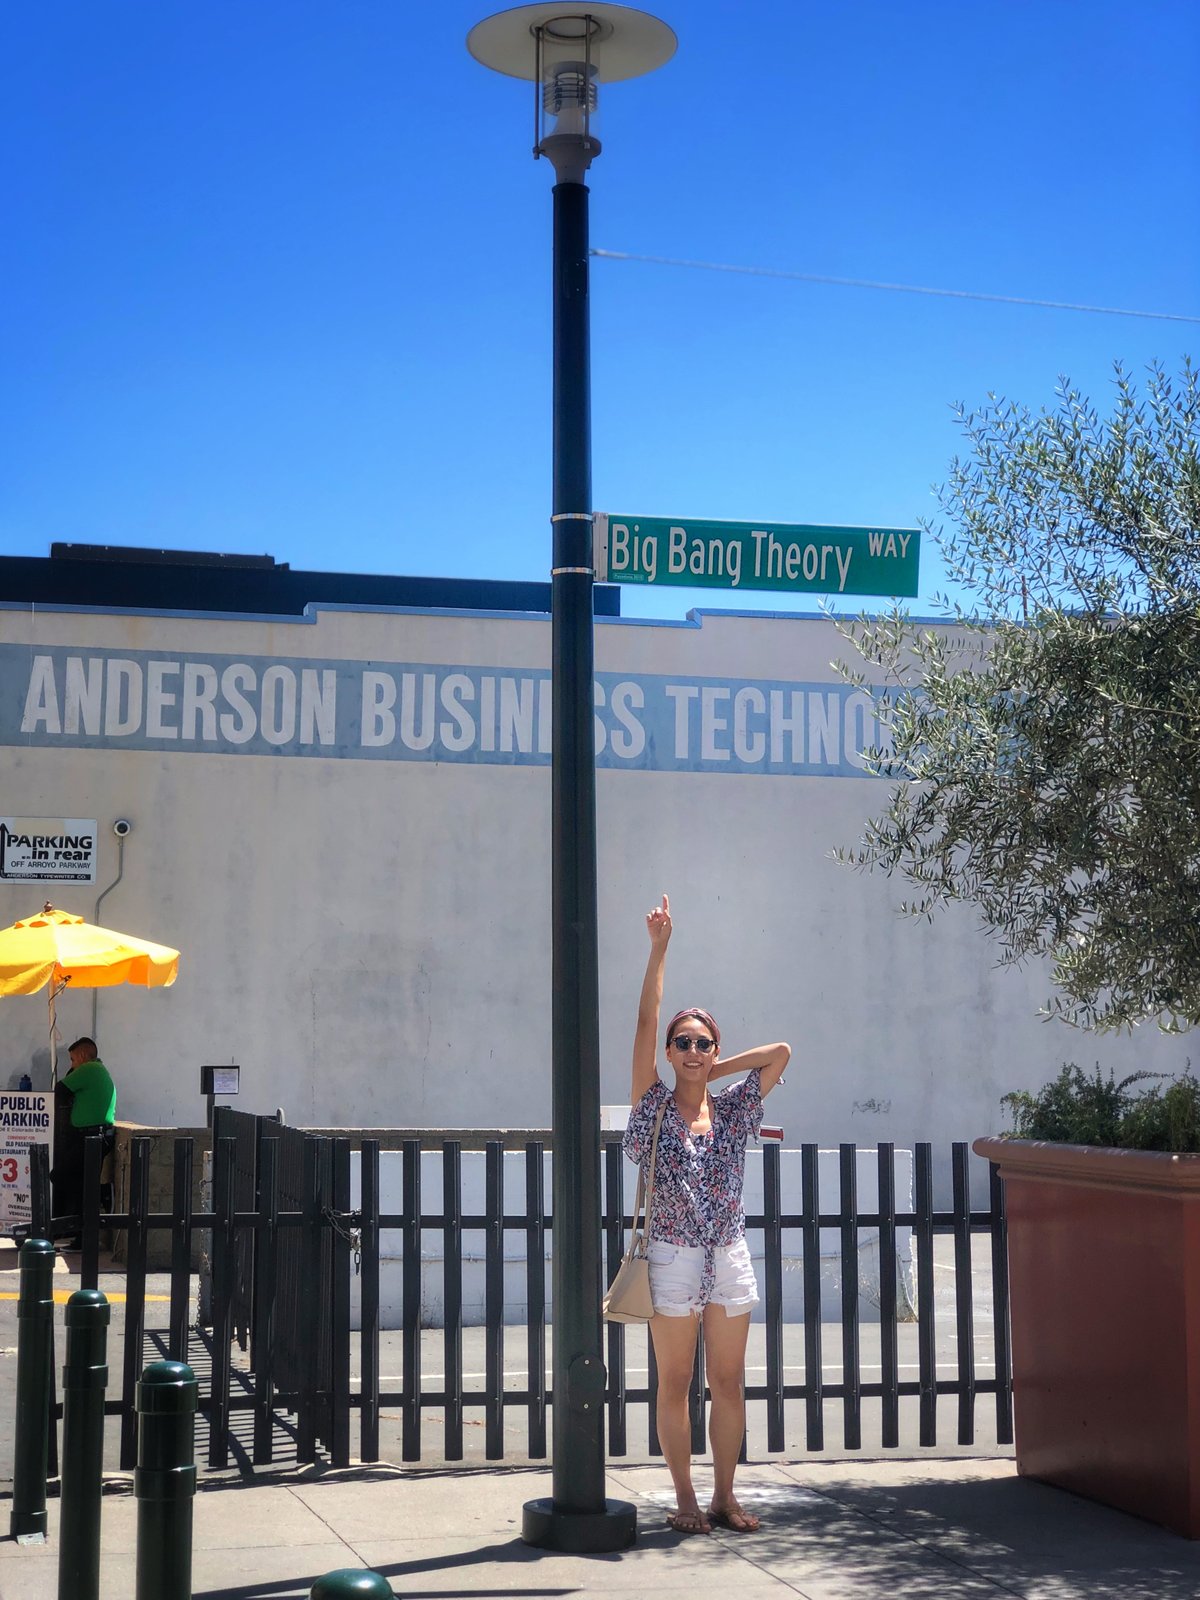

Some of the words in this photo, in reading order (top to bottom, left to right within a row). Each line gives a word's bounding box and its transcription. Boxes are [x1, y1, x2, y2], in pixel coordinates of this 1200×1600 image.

[611, 523, 658, 582] Big
[668, 526, 743, 587] Bang
[751, 530, 853, 592] Theory
[868, 532, 911, 558] WAY
[20, 655, 337, 745] ANDERSON
[6, 834, 93, 849] PARKING
[54, 850, 91, 861] rear
[28, 861, 57, 869] ARROYO
[59, 862, 91, 870] PARKWAY
[0, 1096, 45, 1111] PUBLIC
